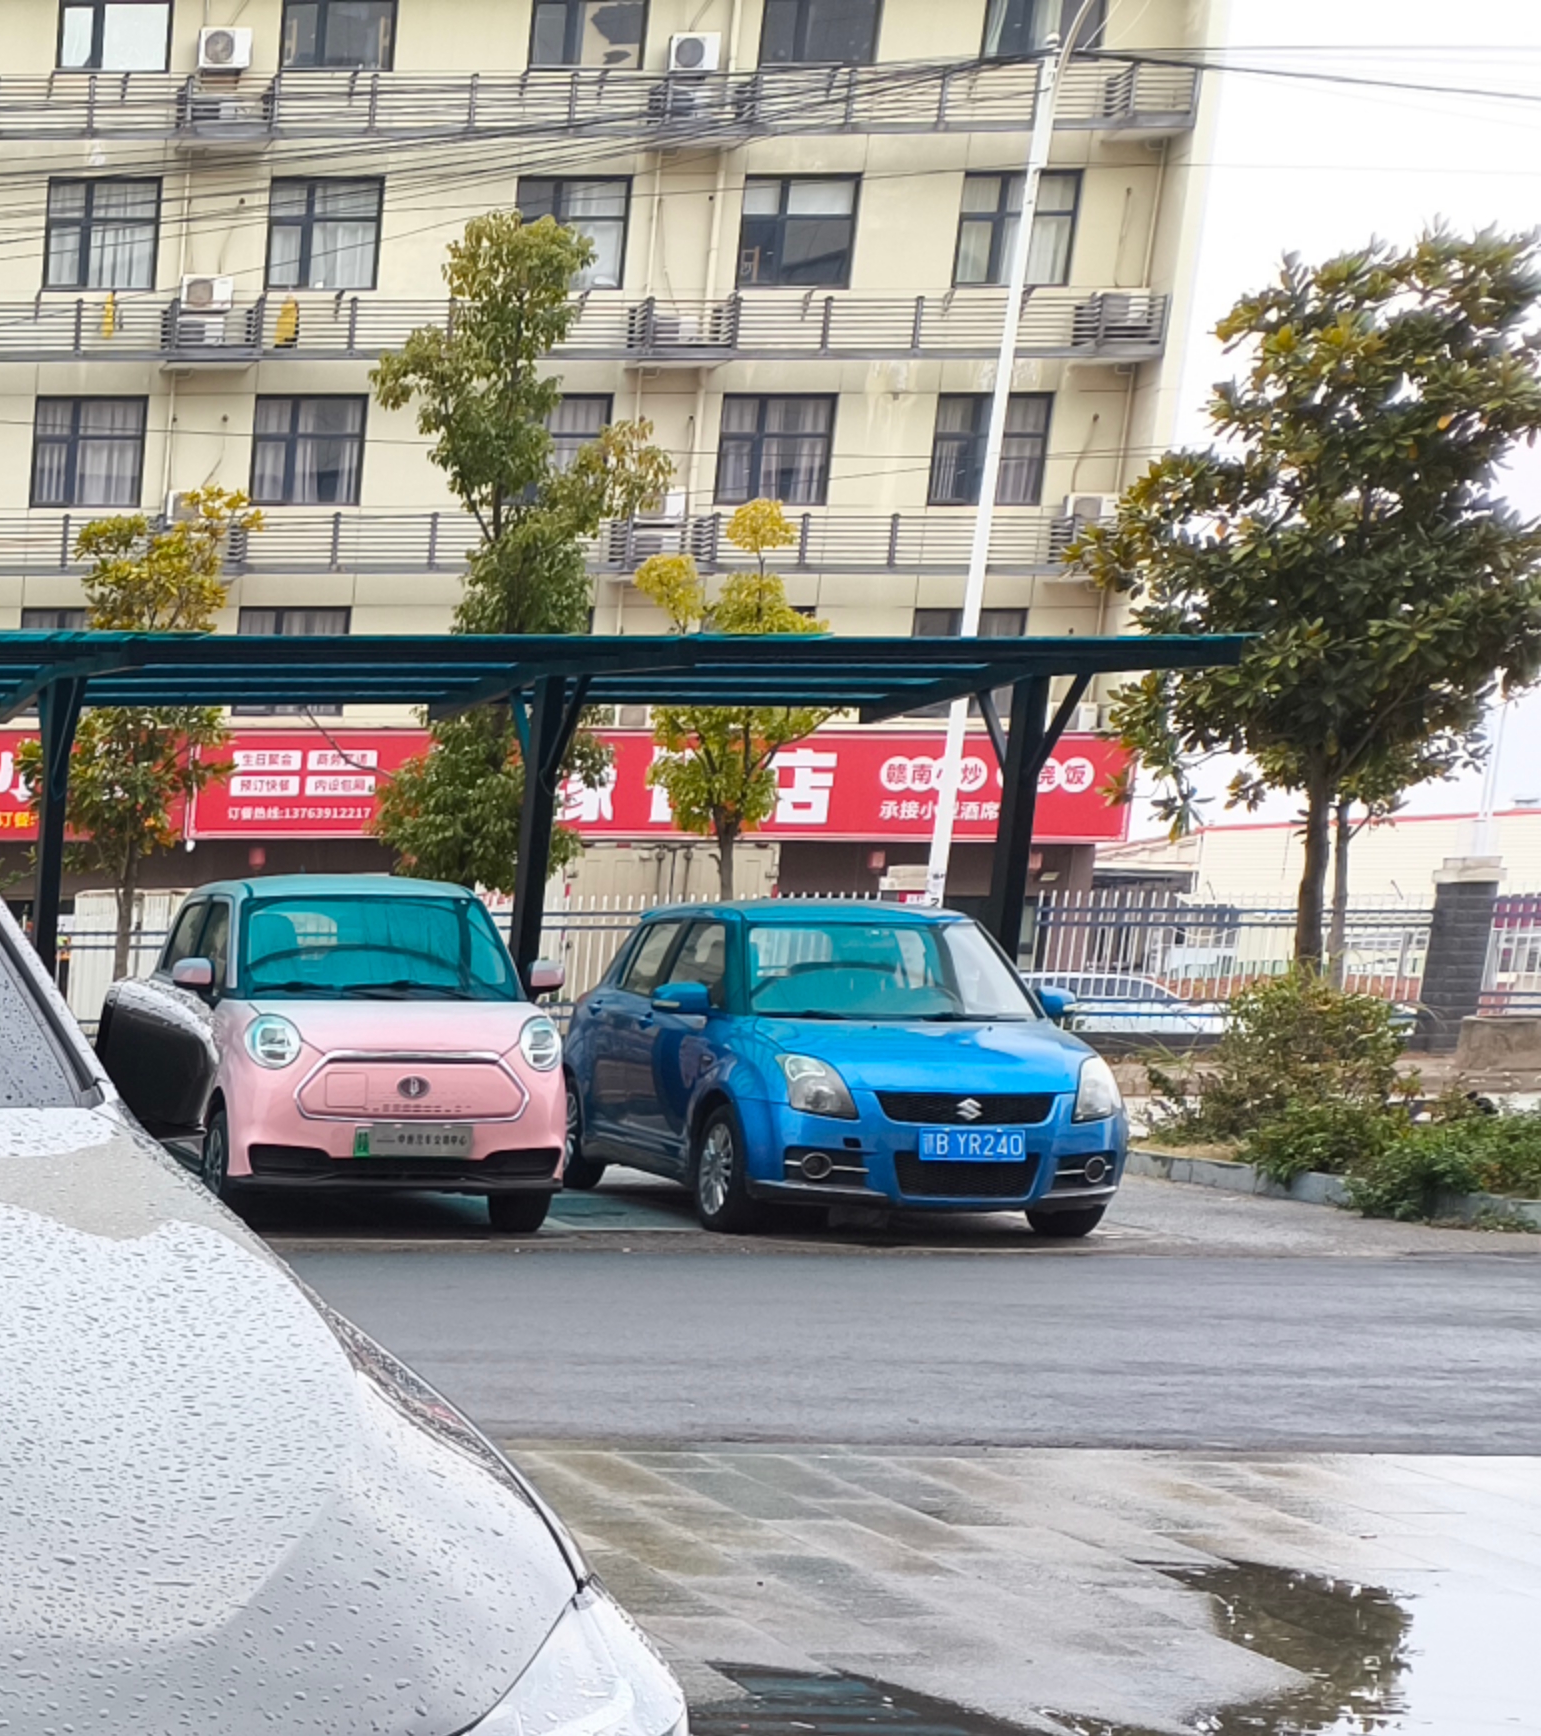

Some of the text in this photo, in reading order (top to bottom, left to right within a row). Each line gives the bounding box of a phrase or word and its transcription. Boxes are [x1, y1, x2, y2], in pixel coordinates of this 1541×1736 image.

[886, 763, 982, 785] 赣南炒
[957, 1133, 1023, 1156] YR240
